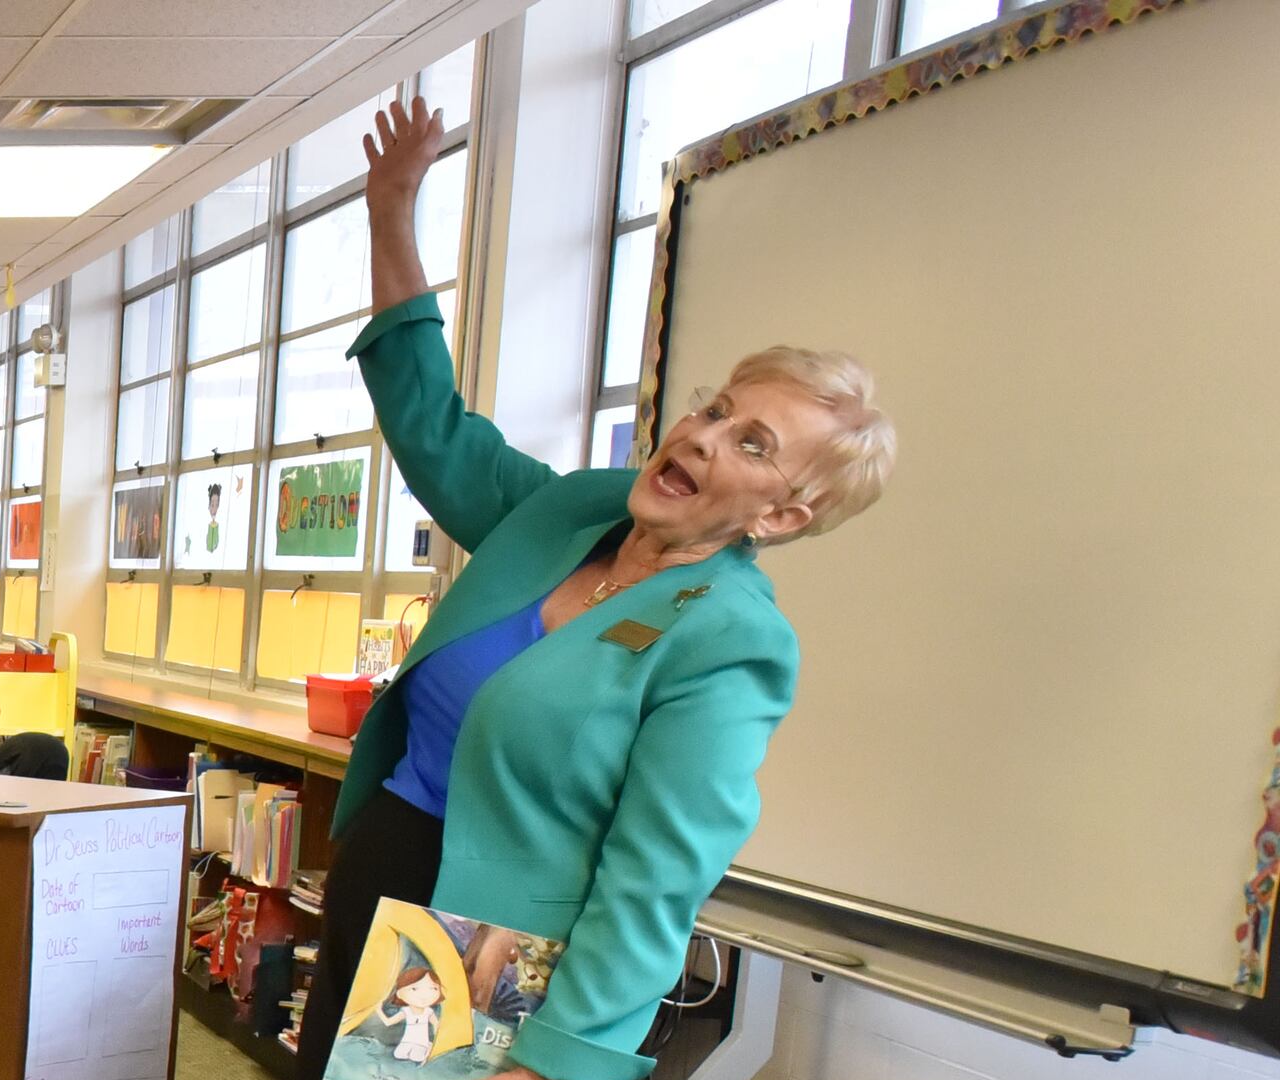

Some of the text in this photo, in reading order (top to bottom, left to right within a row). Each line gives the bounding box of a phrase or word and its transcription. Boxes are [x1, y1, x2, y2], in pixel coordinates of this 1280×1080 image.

[279, 481, 360, 534] QUESTION
[44, 829, 61, 866] Dr
[64, 828, 100, 861] Seuss
[146, 816, 183, 850] Cartoon
[42, 872, 81, 899] Date of
[117, 911, 162, 933] Important
[46, 937, 78, 960] CLUES
[121, 935, 149, 954] Words
